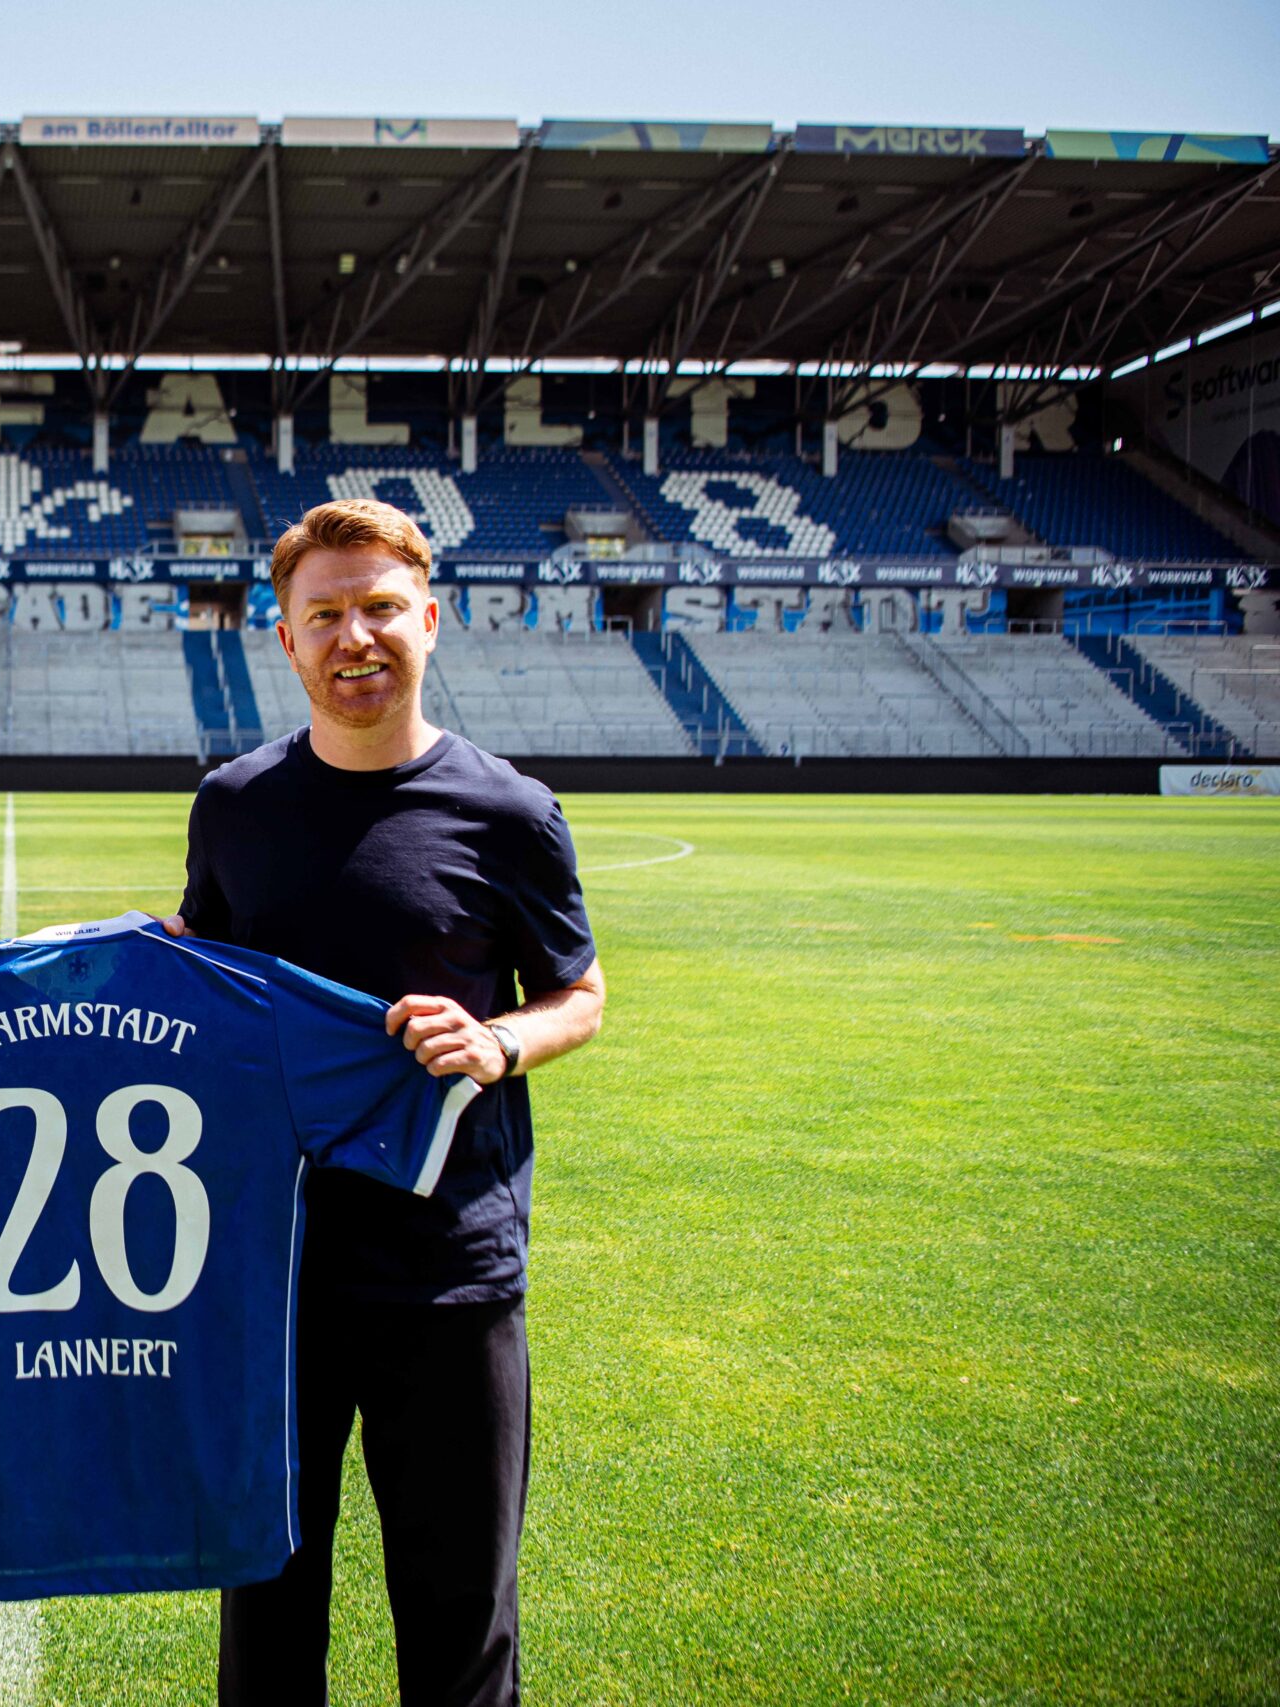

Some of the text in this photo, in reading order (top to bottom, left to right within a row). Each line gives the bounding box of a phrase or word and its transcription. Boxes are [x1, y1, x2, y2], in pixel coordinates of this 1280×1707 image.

[42, 121, 238, 139] am Böllenfalltor
[1190, 769, 1253, 788] declaro
[15, 1337, 178, 1380] LANNERT
